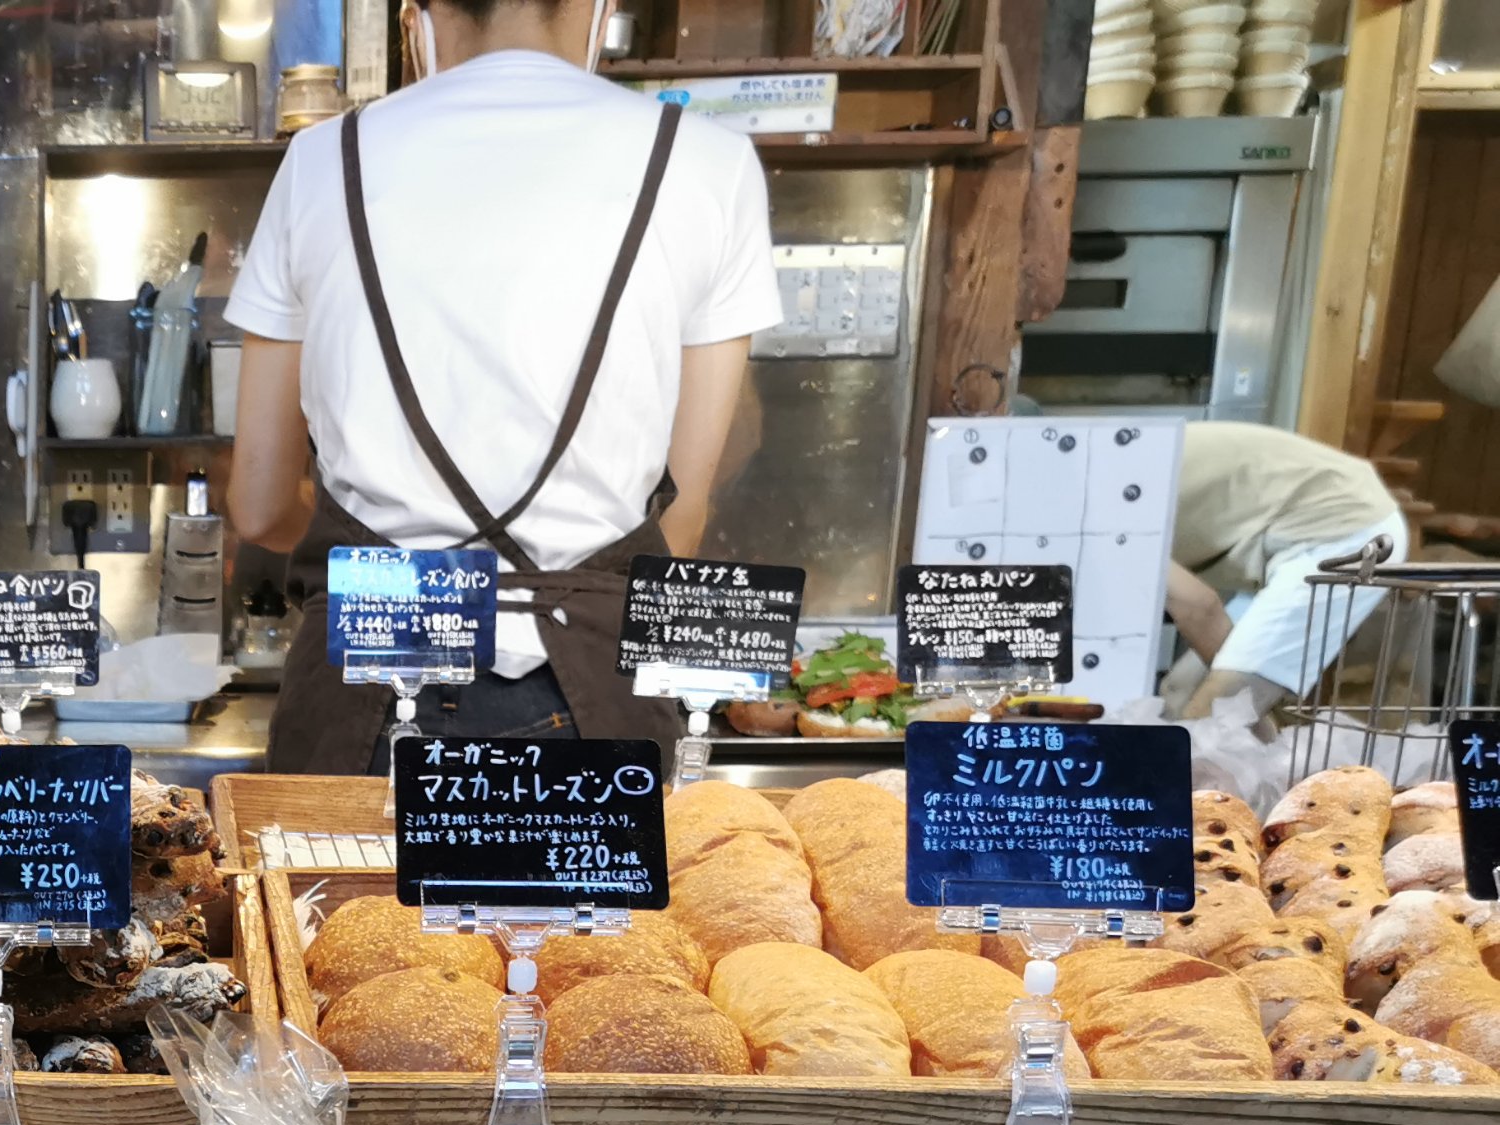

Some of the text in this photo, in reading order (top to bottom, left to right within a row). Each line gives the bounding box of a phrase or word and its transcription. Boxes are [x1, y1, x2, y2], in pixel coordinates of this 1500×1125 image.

[350, 549, 411, 565] オーガニック
[918, 570, 1036, 590] なたね丸パン
[962, 725, 1064, 751] 低温殺菌
[1462, 733, 1500, 769] オー
[423, 739, 541, 767] オーガニック
[952, 753, 1102, 788] ミルクパン
[418, 770, 613, 804] マスカットレーズン
